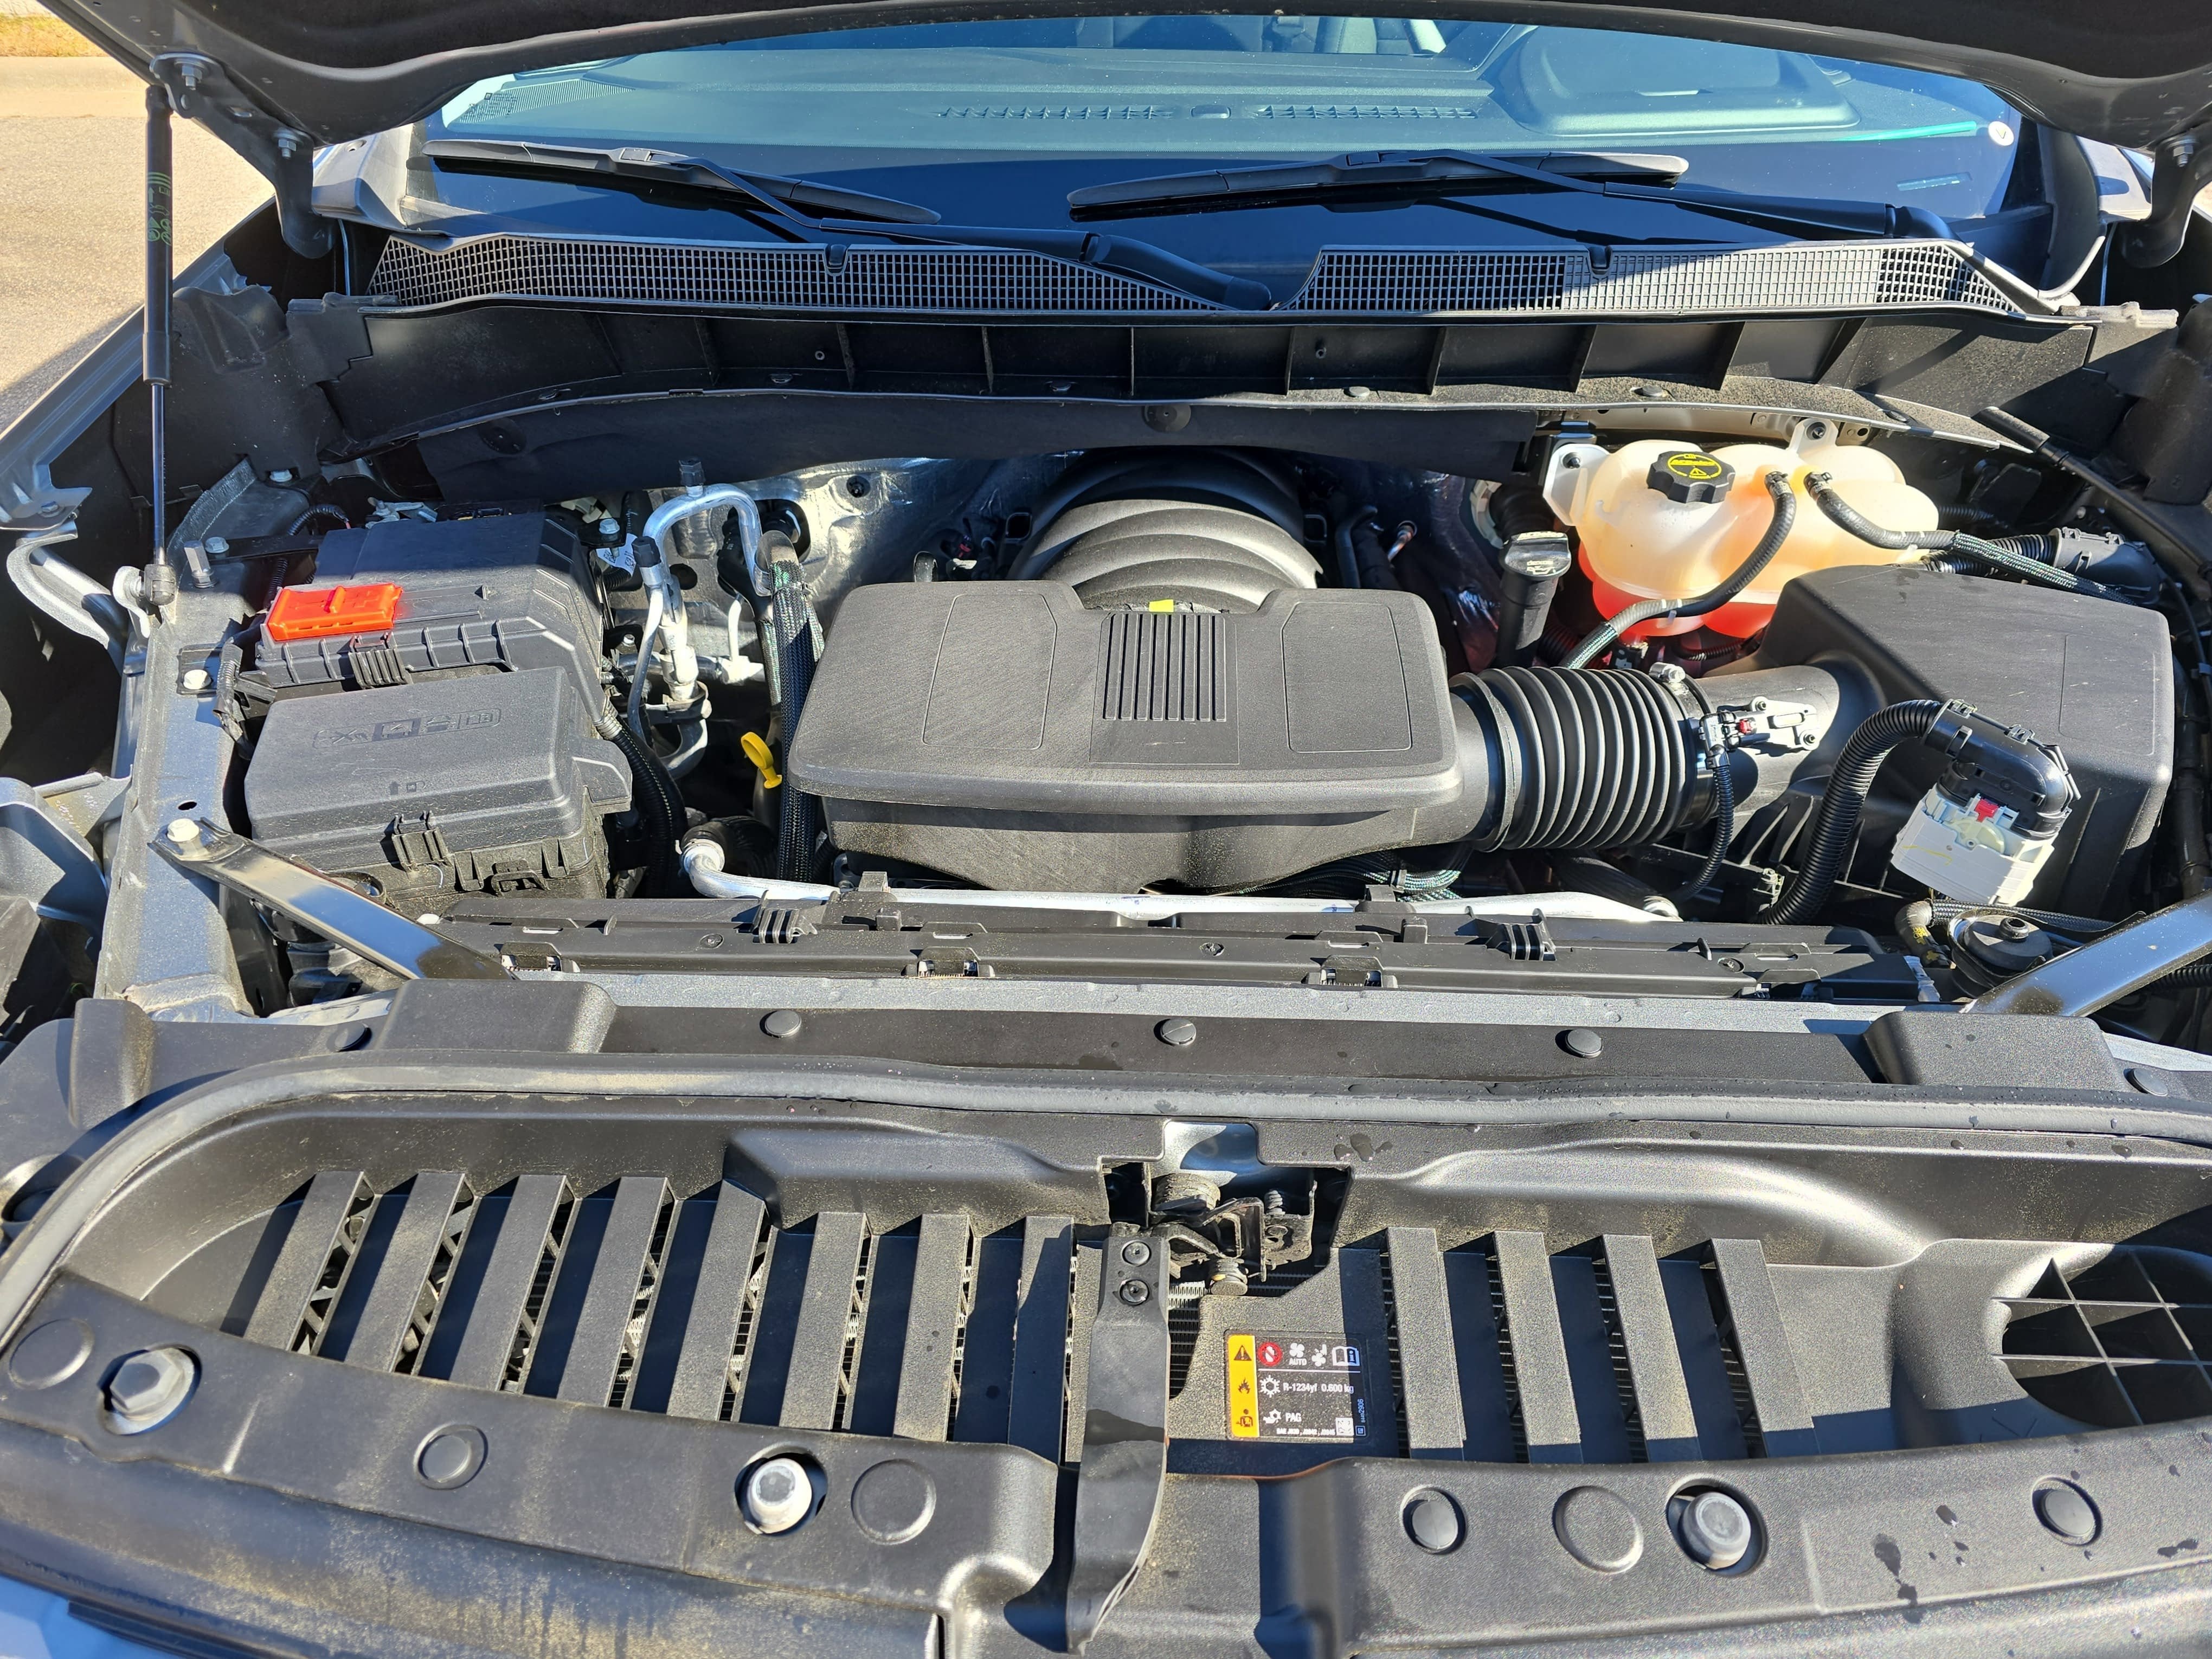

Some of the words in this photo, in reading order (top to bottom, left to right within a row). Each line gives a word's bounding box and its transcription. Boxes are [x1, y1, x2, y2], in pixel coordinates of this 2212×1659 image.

[1283, 1382, 1317, 1393] R-1234yf
[1344, 1384, 1354, 1393] kg
[1285, 1413, 1302, 1422] PAG
